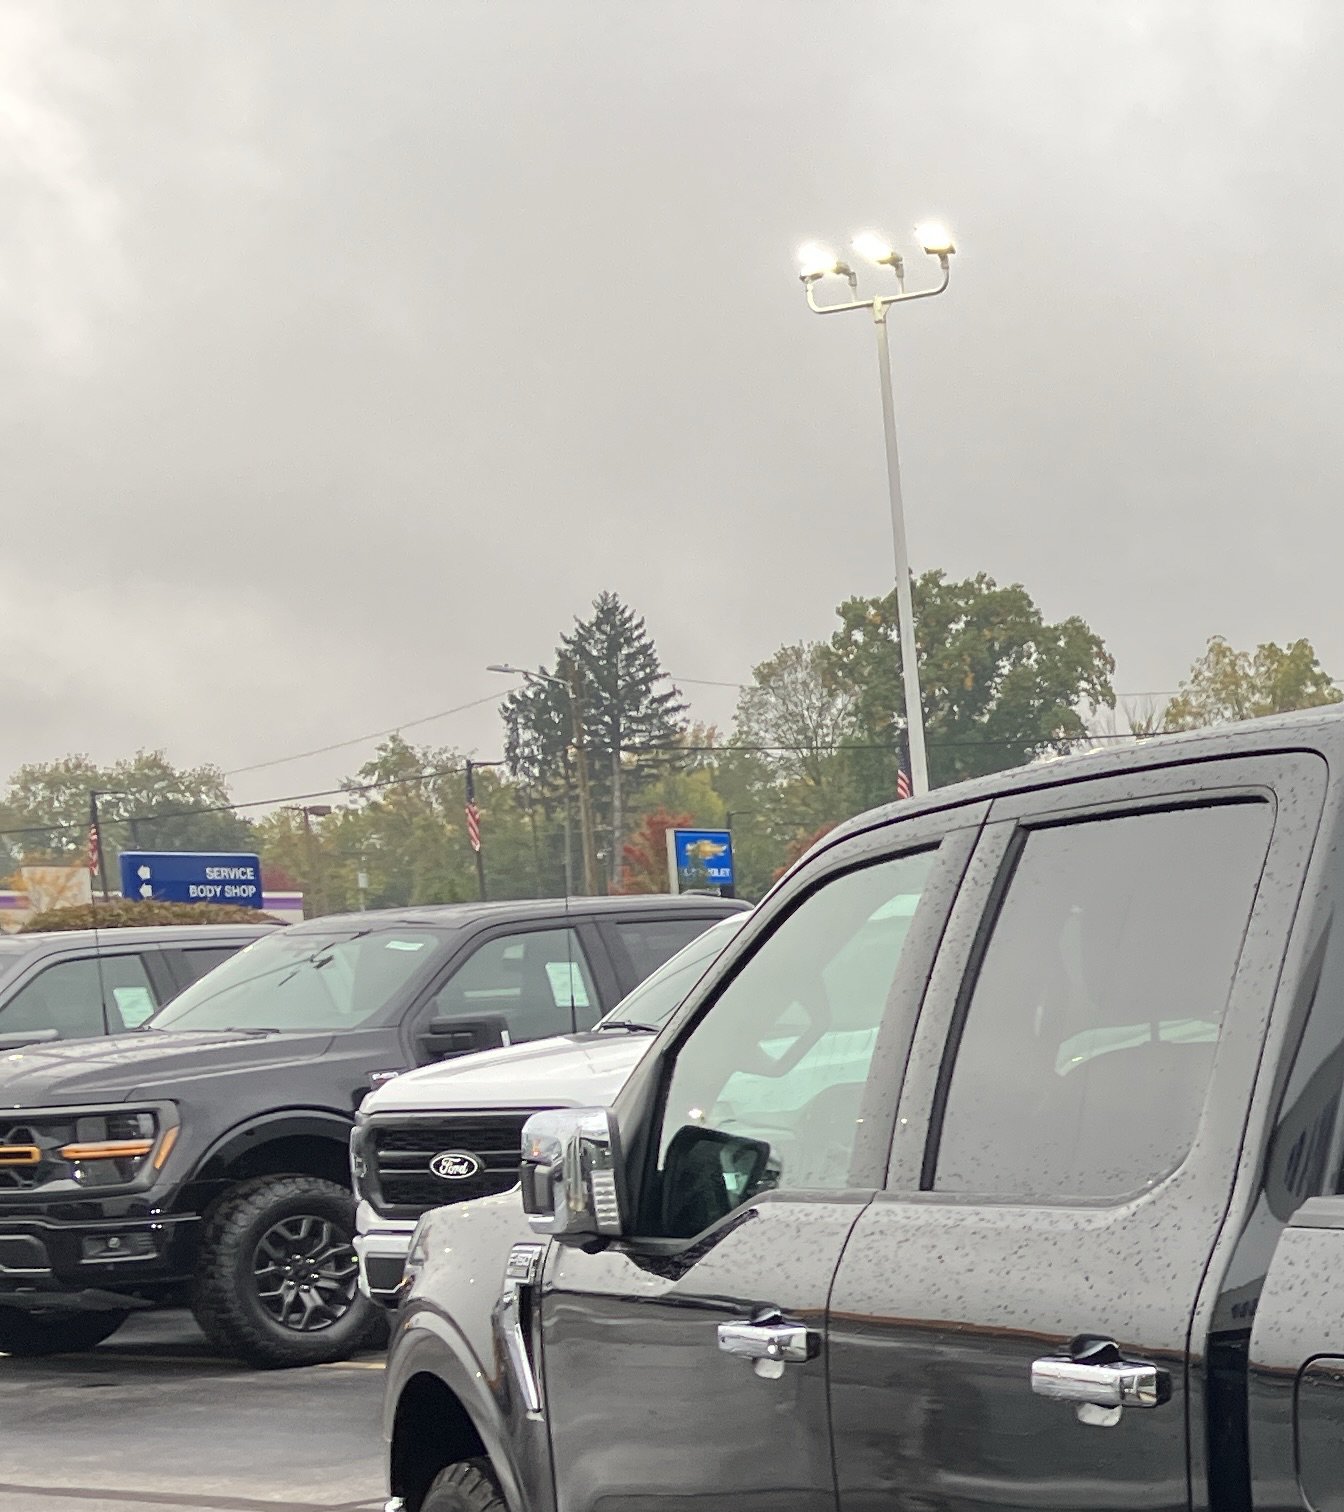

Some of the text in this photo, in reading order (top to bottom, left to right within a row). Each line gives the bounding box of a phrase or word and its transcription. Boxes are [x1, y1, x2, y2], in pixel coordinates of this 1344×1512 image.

[206, 868, 255, 880] SERVICE
[188, 884, 257, 898] BODY SHOP
[439, 1157, 469, 1175] Ford
